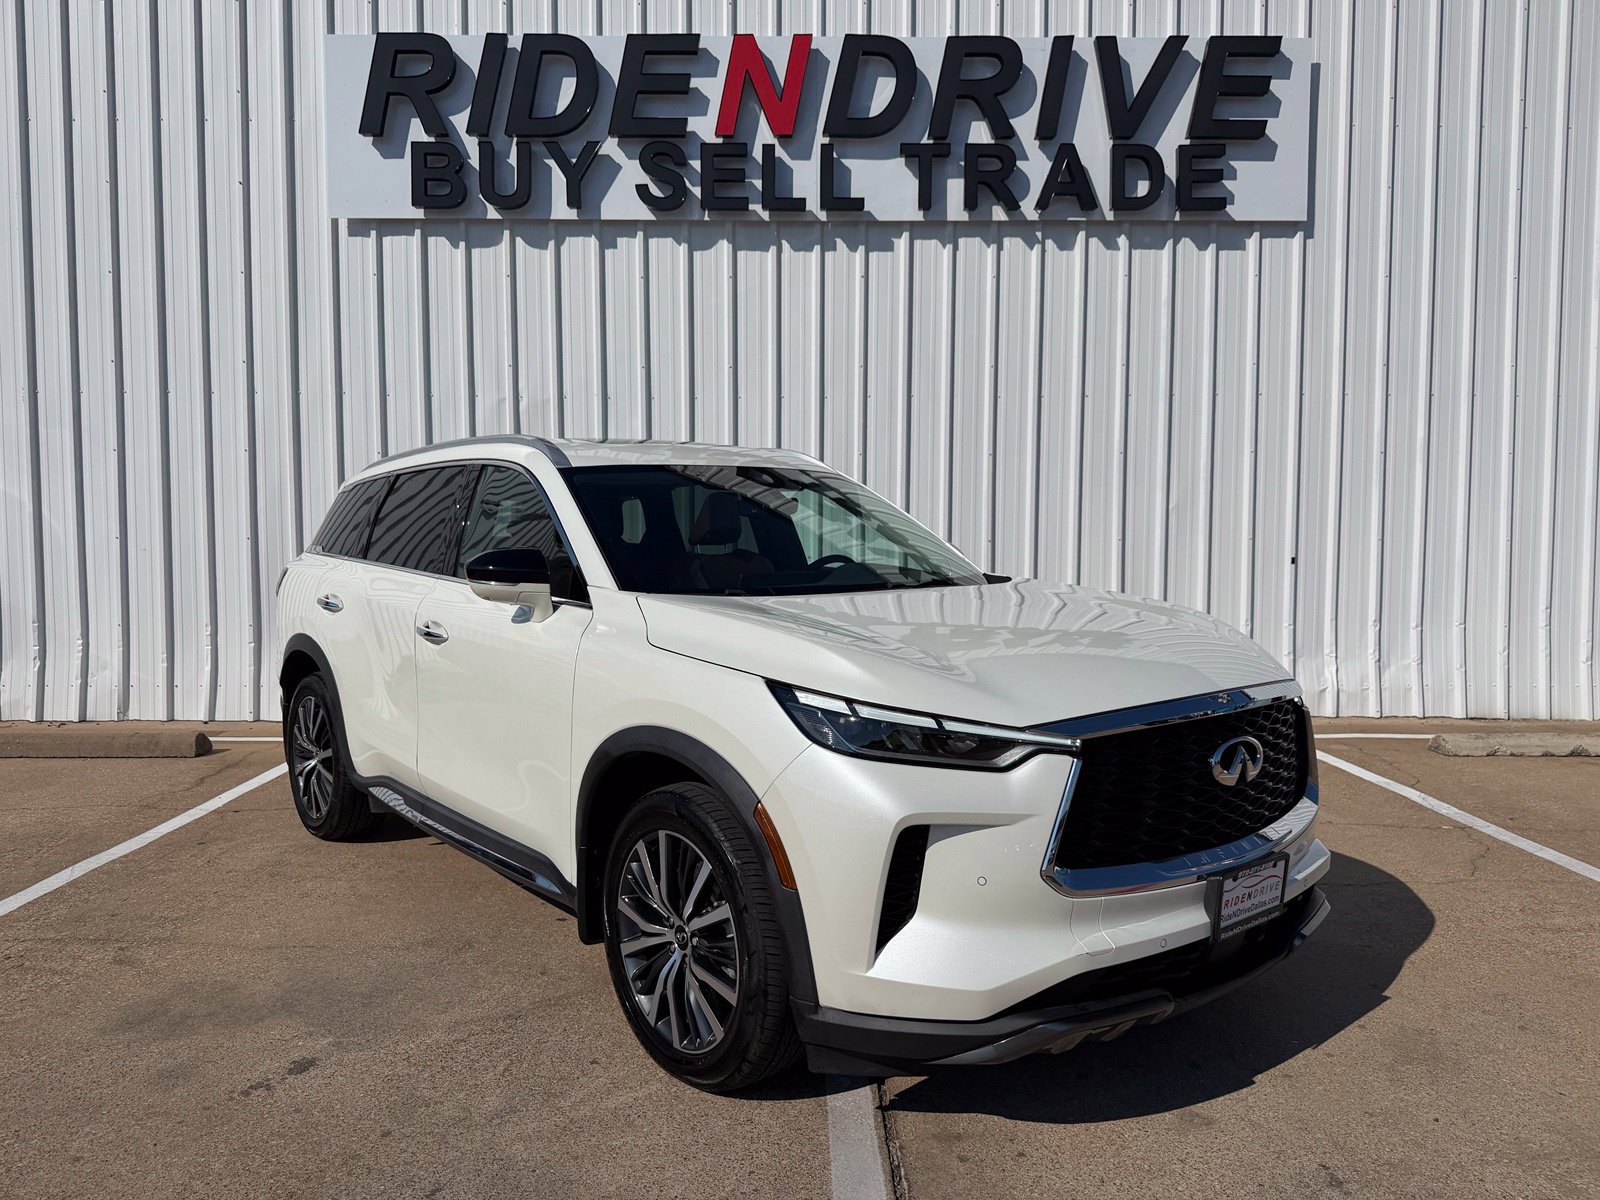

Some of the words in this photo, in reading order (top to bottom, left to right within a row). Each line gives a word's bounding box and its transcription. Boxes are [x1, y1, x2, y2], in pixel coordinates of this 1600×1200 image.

[358, 32, 1283, 139] RIDENDRIVE
[411, 141, 602, 209] BUY
[634, 141, 865, 212] SELL
[900, 142, 1228, 212] TRADE
[1220, 895, 1280, 923] RideNDriveDallas.com
[1223, 880, 1281, 910] RIDENDRIVE
